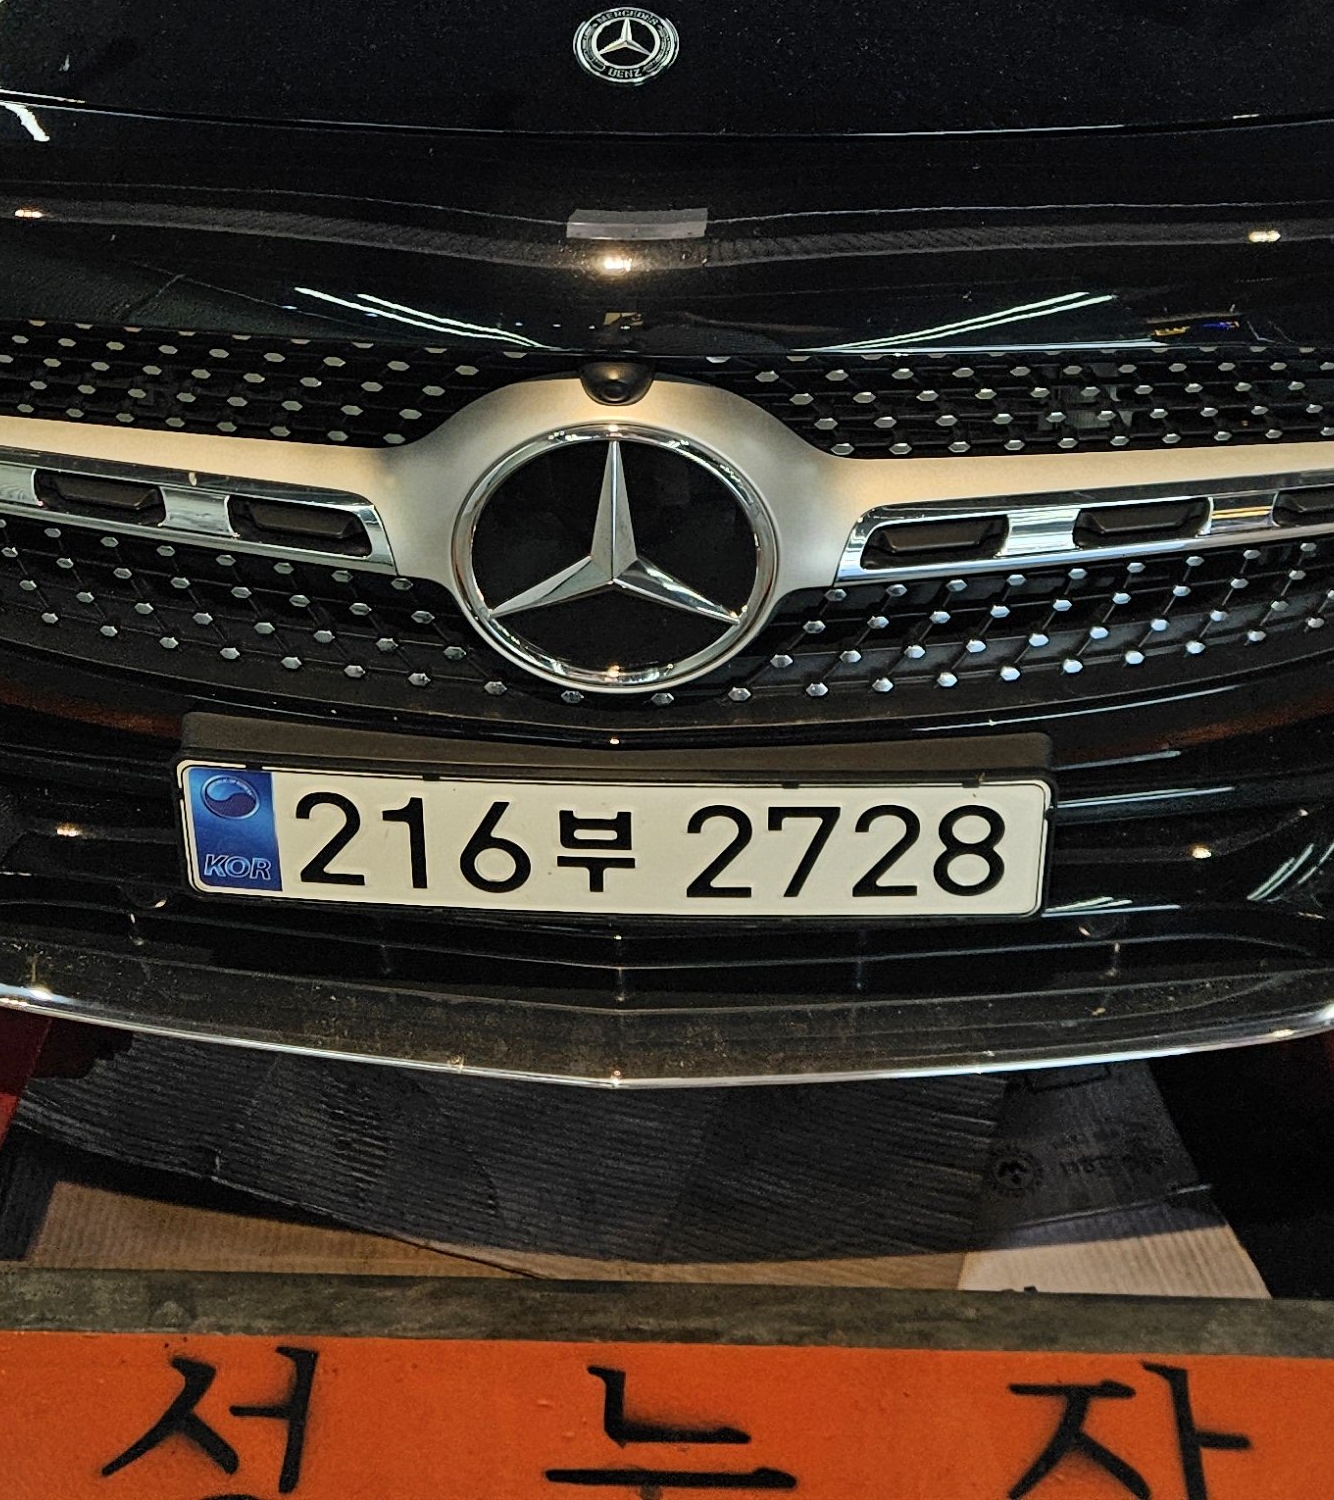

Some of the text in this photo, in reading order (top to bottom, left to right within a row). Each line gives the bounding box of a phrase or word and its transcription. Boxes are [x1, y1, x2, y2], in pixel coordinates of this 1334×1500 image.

[203, 853, 272, 881] KOR
[295, 790, 1006, 898] 216부 2728
